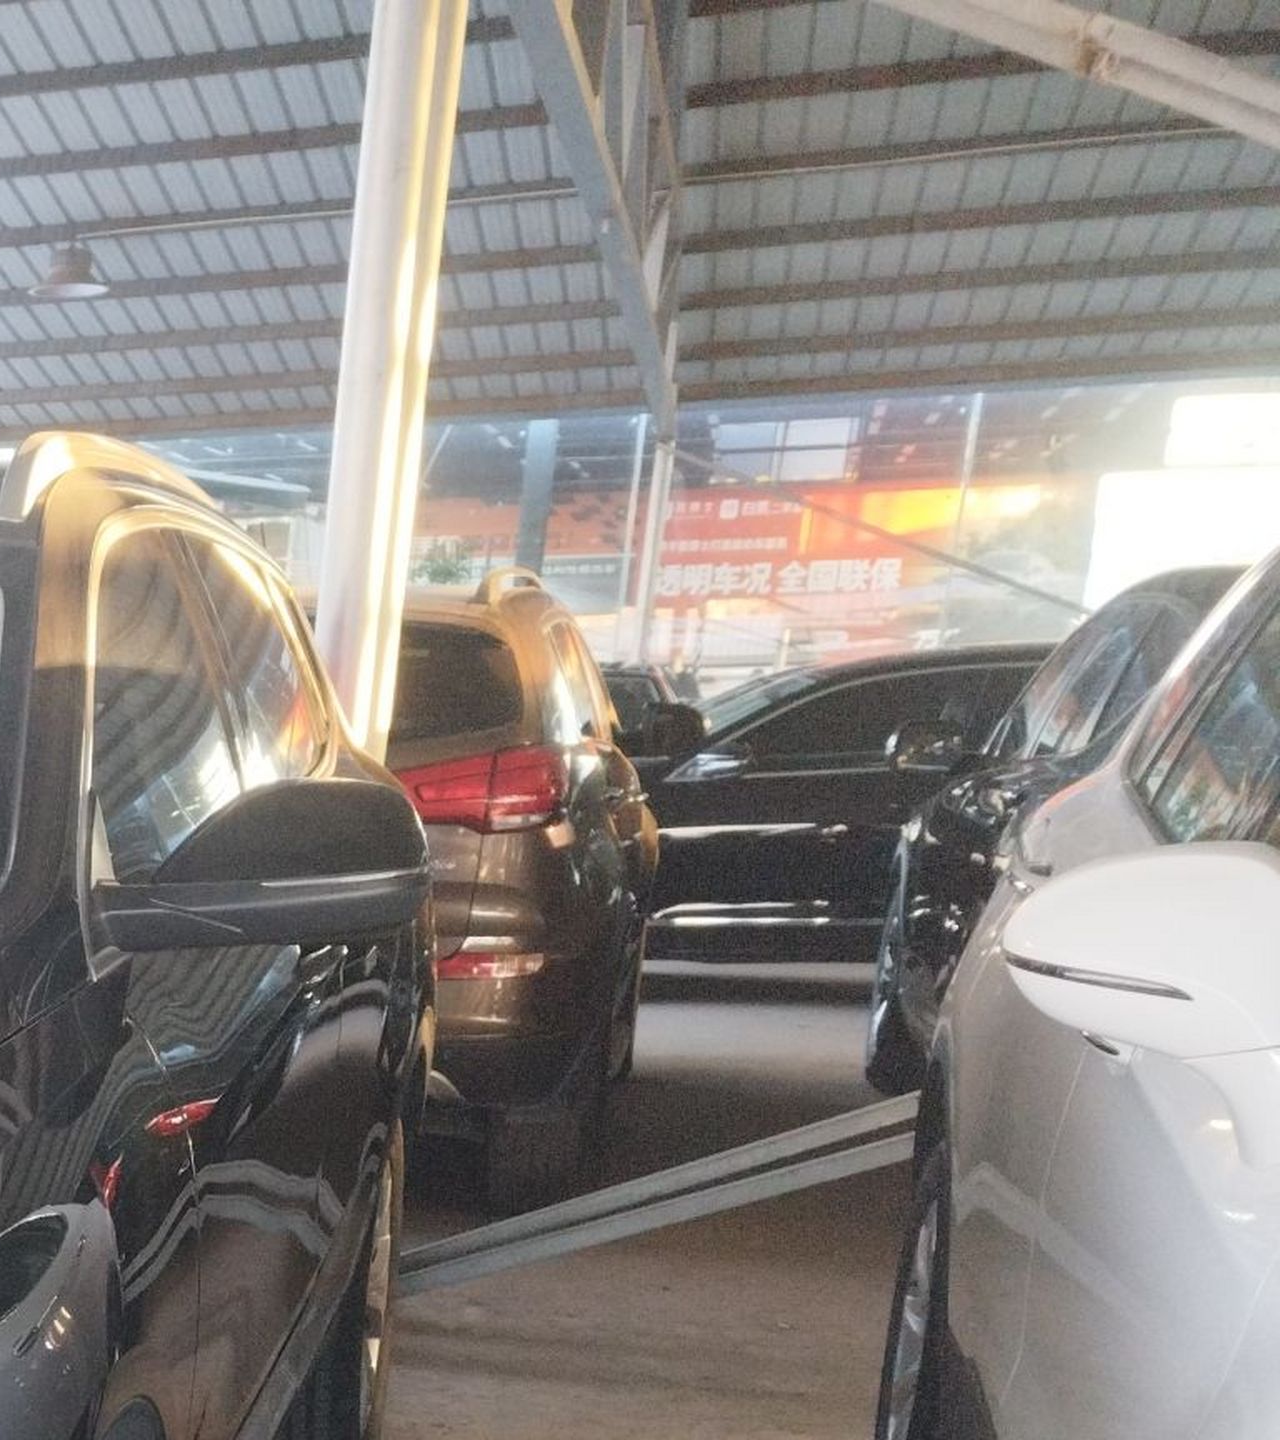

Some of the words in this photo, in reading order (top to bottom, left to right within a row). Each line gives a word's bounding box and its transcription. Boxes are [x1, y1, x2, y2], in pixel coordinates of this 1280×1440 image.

[655, 562, 773, 597] 透明车况
[777, 557, 903, 594] 全国联保
